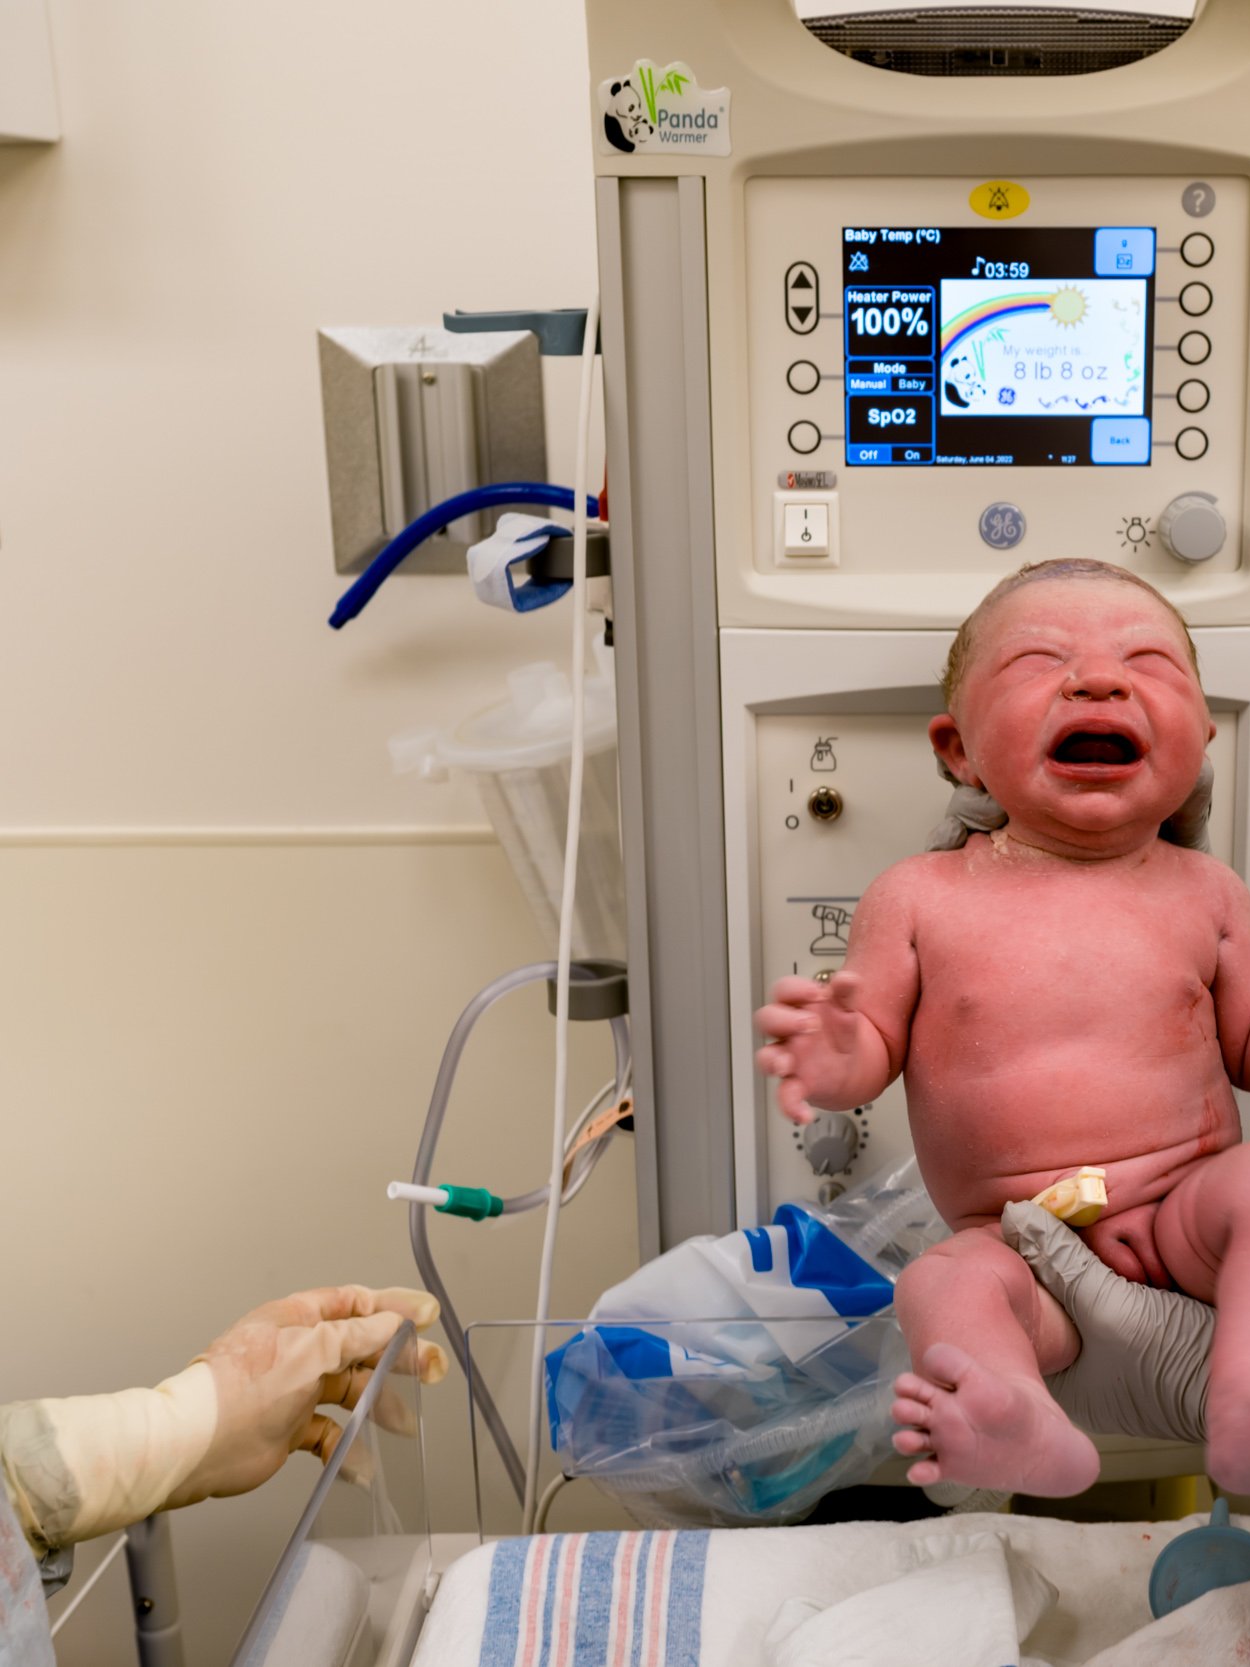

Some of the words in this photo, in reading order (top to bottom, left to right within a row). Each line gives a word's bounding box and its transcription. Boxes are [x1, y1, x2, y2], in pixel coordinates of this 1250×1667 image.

[659, 131, 708, 144] Warmer
[845, 229, 877, 244] Baby
[880, 229, 913, 244] Temp
[984, 261, 1030, 279] 03:59
[847, 290, 889, 303] Heater
[892, 290, 932, 303] Power
[851, 307, 929, 336] 100%
[1003, 345, 1021, 359] My
[1025, 344, 1068, 359] weight
[873, 362, 907, 374] Mode
[1014, 361, 1027, 380] 8
[1034, 361, 1053, 380] lb
[1061, 361, 1073, 380] 8
[1081, 365, 1108, 380] oz
[850, 379, 887, 389] Manual
[898, 379, 926, 391] Baby
[868, 408, 916, 428] SpO2
[1109, 436, 1130, 445] Back
[860, 450, 878, 460] Off
[904, 450, 920, 460] On
[969, 455, 984, 464] June
